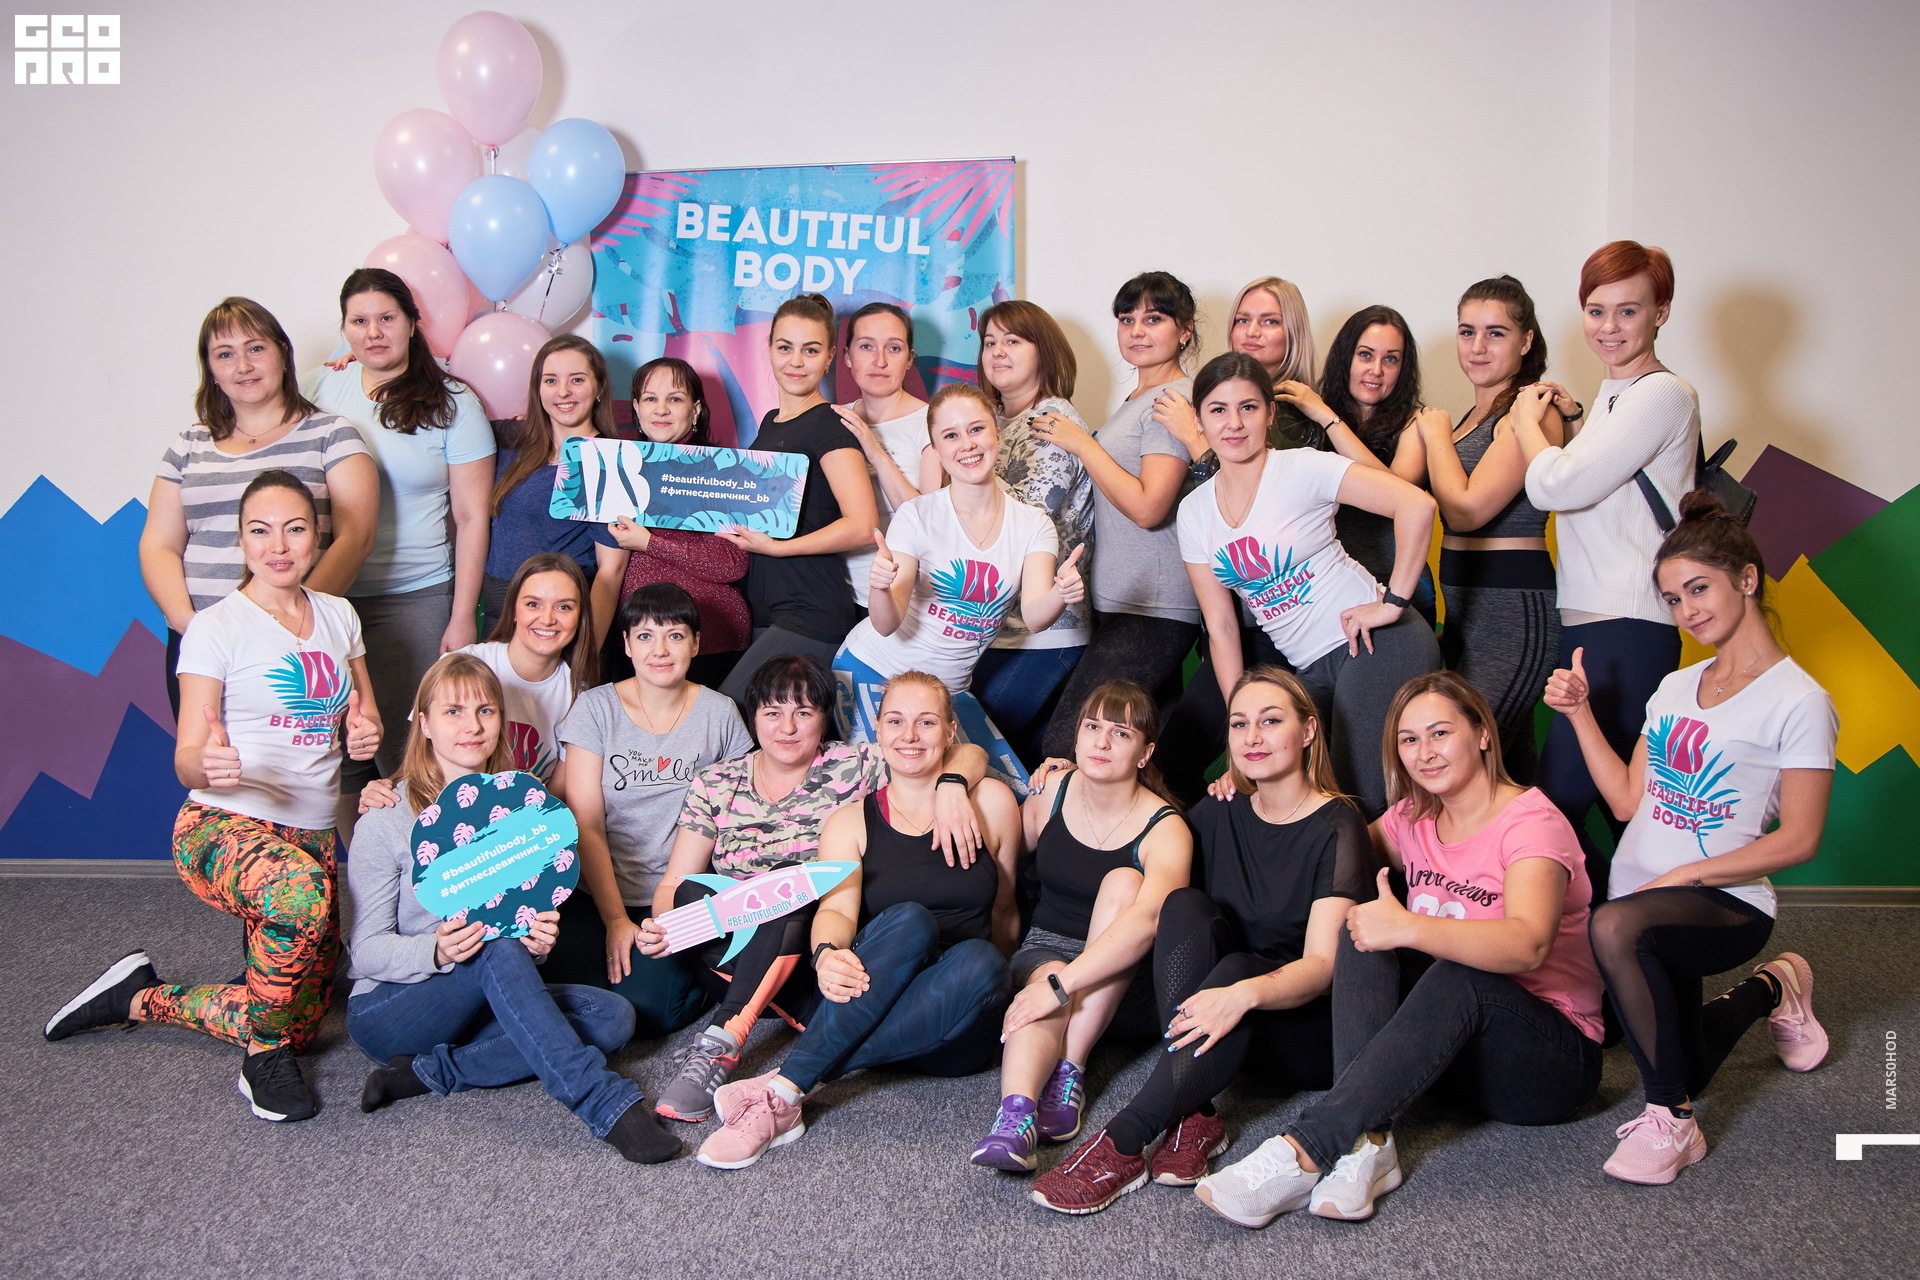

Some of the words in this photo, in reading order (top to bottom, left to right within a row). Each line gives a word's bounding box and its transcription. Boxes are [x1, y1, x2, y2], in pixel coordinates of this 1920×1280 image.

[676, 202, 930, 255] BEAUTIFUL
[733, 250, 866, 295] BODY
[660, 486, 770, 503] #фитнесдевичник_bb
[661, 473, 757, 490] #beautifulbody_bb
[1262, 594, 1300, 621] BODY
[942, 626, 988, 642] BODY
[292, 732, 335, 746] BODY
[1647, 778, 1735, 819] BEAUTIFUL
[1652, 805, 1703, 834] BODY
[440, 833, 561, 898] #фитнесдевичник_bb
[441, 823, 548, 881] #beautifulbody_bb
